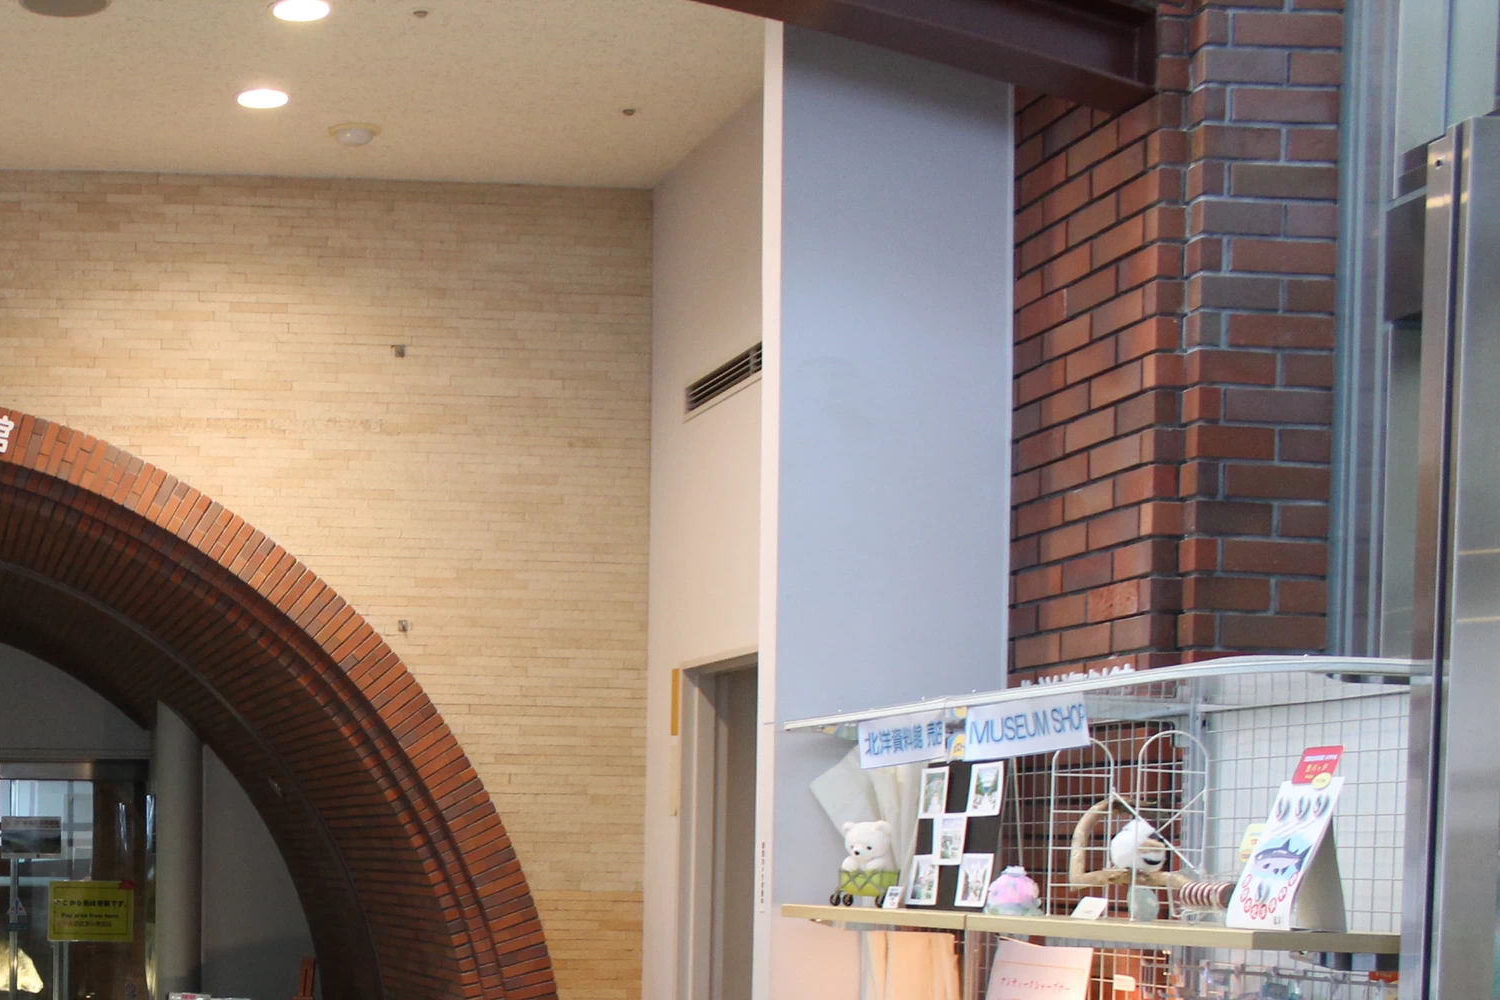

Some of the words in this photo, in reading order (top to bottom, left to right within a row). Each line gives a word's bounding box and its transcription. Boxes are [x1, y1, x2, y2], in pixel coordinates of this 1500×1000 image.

[865, 723, 923, 756] 北洋資料館
[969, 710, 1049, 745] MUSEUM
[1051, 703, 1085, 733] SHOP
